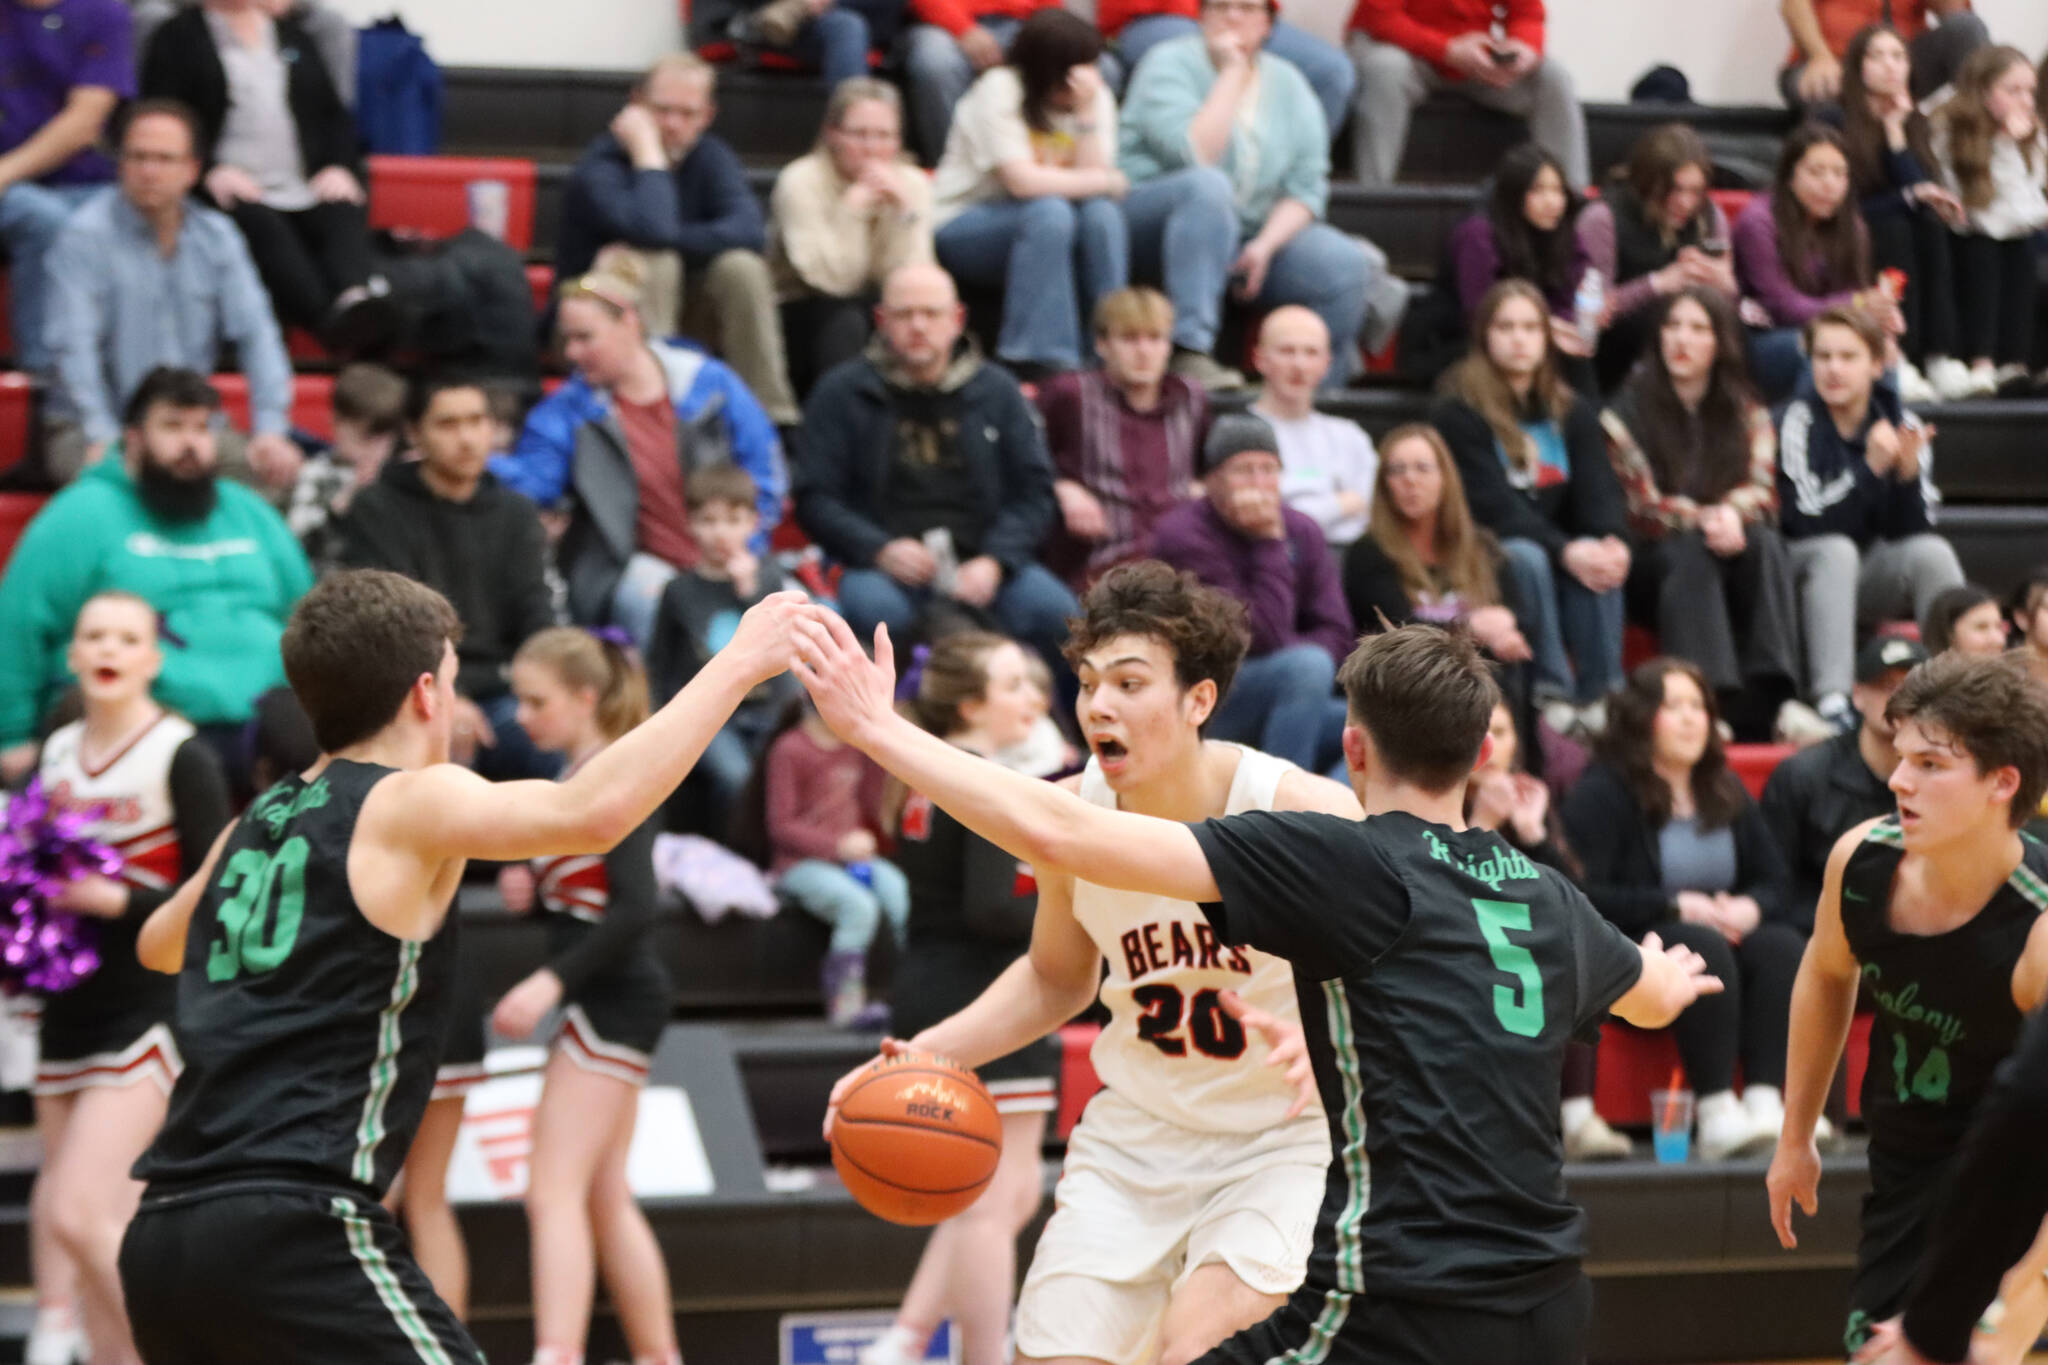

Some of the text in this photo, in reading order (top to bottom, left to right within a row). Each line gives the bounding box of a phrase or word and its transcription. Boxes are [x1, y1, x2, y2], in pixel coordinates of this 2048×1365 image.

[206, 836, 310, 982] 30
[1121, 921, 1252, 982] BEARS
[1471, 898, 1545, 1038] 5
[1131, 983, 1248, 1061] 20
[906, 1102, 954, 1121] ROCK
